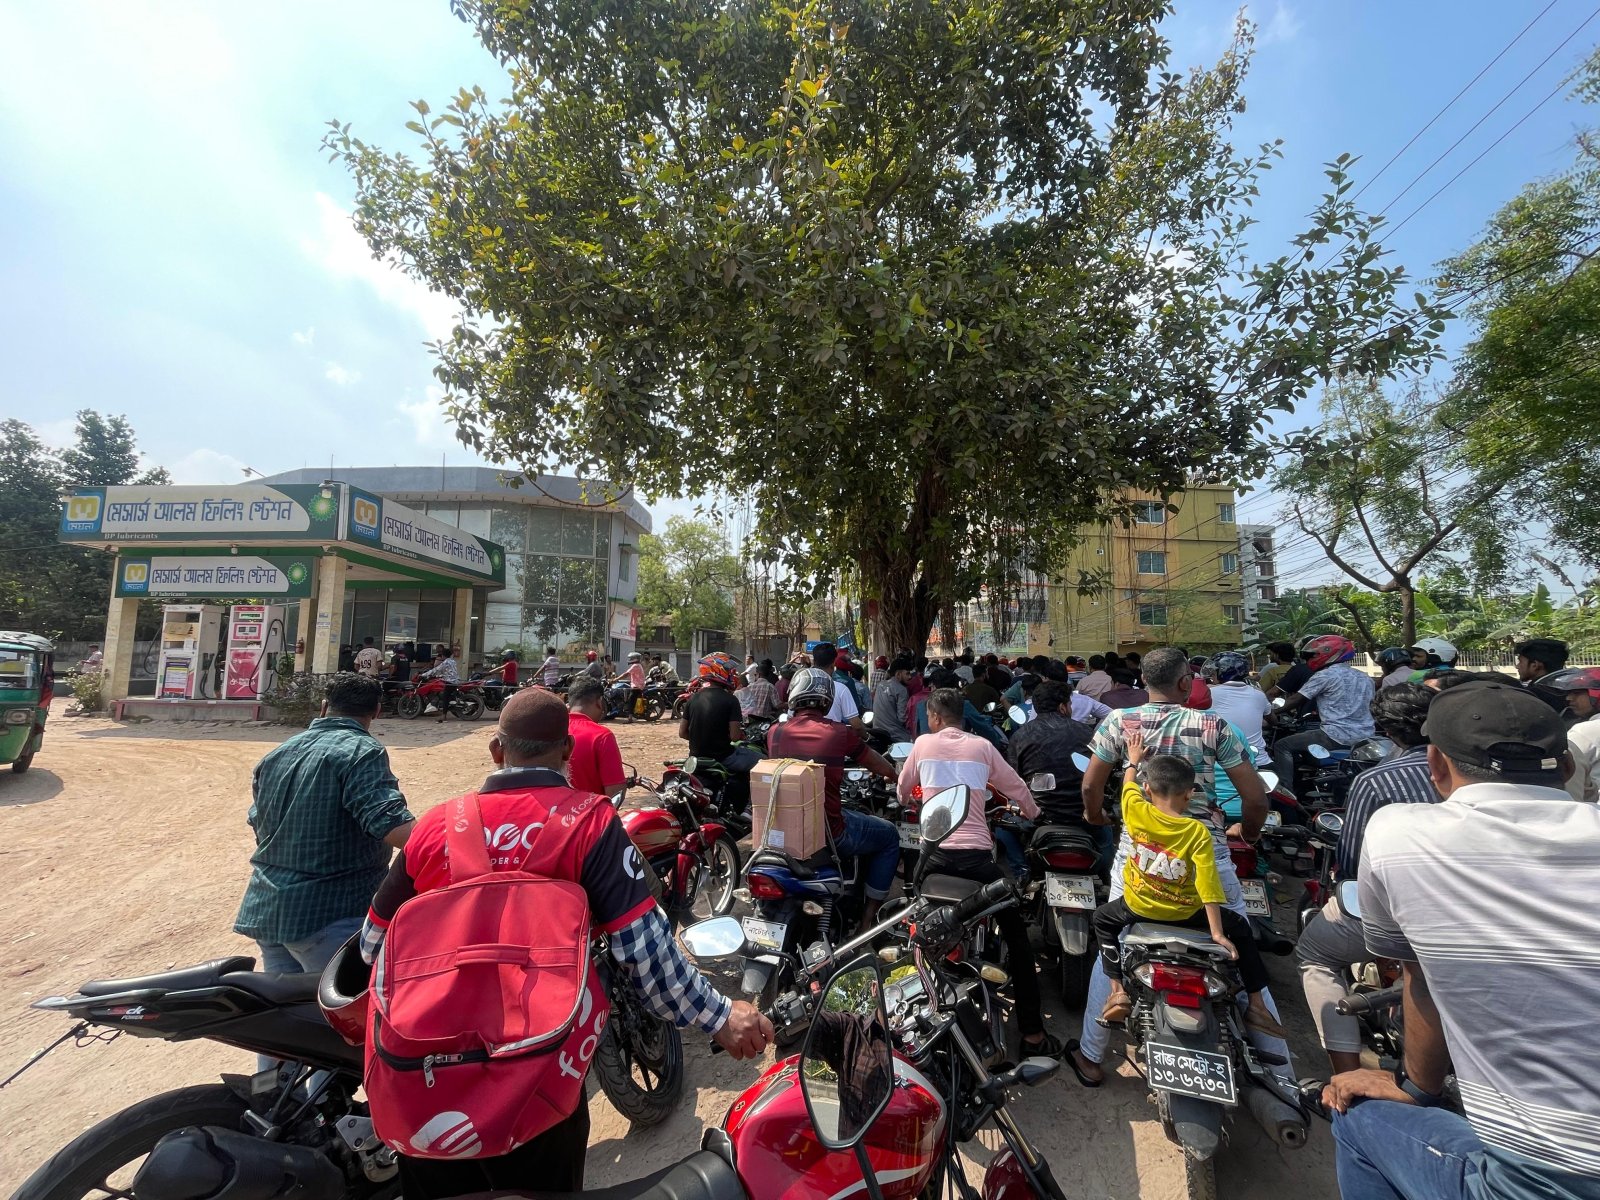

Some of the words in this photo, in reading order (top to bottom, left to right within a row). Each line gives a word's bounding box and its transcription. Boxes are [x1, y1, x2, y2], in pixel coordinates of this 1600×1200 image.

[107, 497, 151, 521] মেসার্স
[154, 502, 198, 521] আলম
[201, 498, 244, 521] ফিলিং
[249, 496, 293, 521] স্টেশন
[384, 516, 413, 542] মেসার্স
[415, 527, 440, 551] আলম
[442, 535, 463, 559] ফিলিং
[466, 544, 484, 565] স্টেশন
[152, 565, 181, 583] মেসার্স
[184, 569, 213, 584] আলম
[216, 566, 244, 583] ফিলিং
[248, 565, 277, 583] স্টেশন
[490, 857, 508, 865] DER
[1153, 1050, 1176, 1067] রাজ
[1153, 1067, 1228, 1095] ১৩-৬৭৩৭
